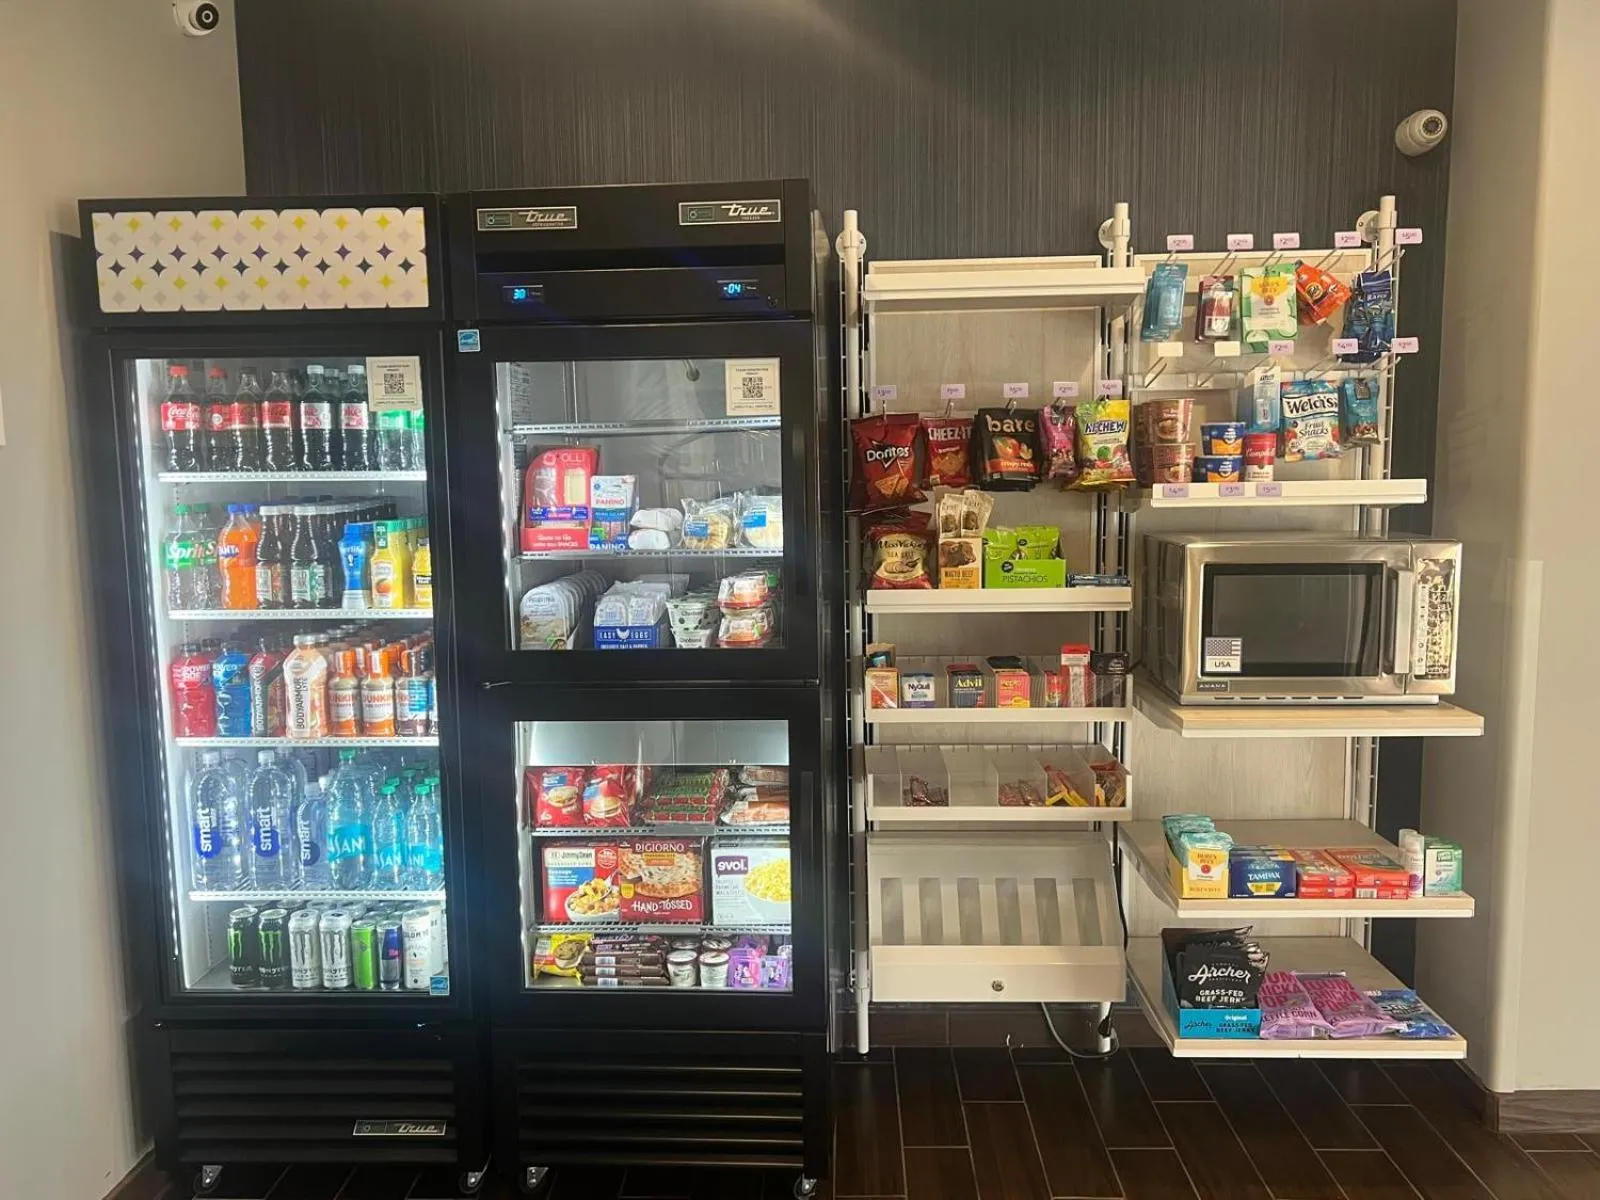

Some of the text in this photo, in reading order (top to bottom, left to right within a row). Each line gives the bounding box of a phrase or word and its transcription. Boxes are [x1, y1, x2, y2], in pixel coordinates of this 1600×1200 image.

[723, 284, 741, 293] -04
[986, 414, 1034, 432] bare
[866, 445, 911, 461] Doritos
[1002, 575, 1047, 583] PISTACHIOS
[956, 679, 982, 688] Advil
[197, 807, 212, 853] smart
[257, 806, 272, 852] smart
[300, 819, 311, 861] smart
[635, 843, 684, 852] DIGIORNO
[1247, 872, 1281, 880] TAMPAX
[1187, 964, 1251, 985] Archer
[1199, 989, 1244, 997] GRASS-FED
[1291, 1009, 1318, 1018] CORN
